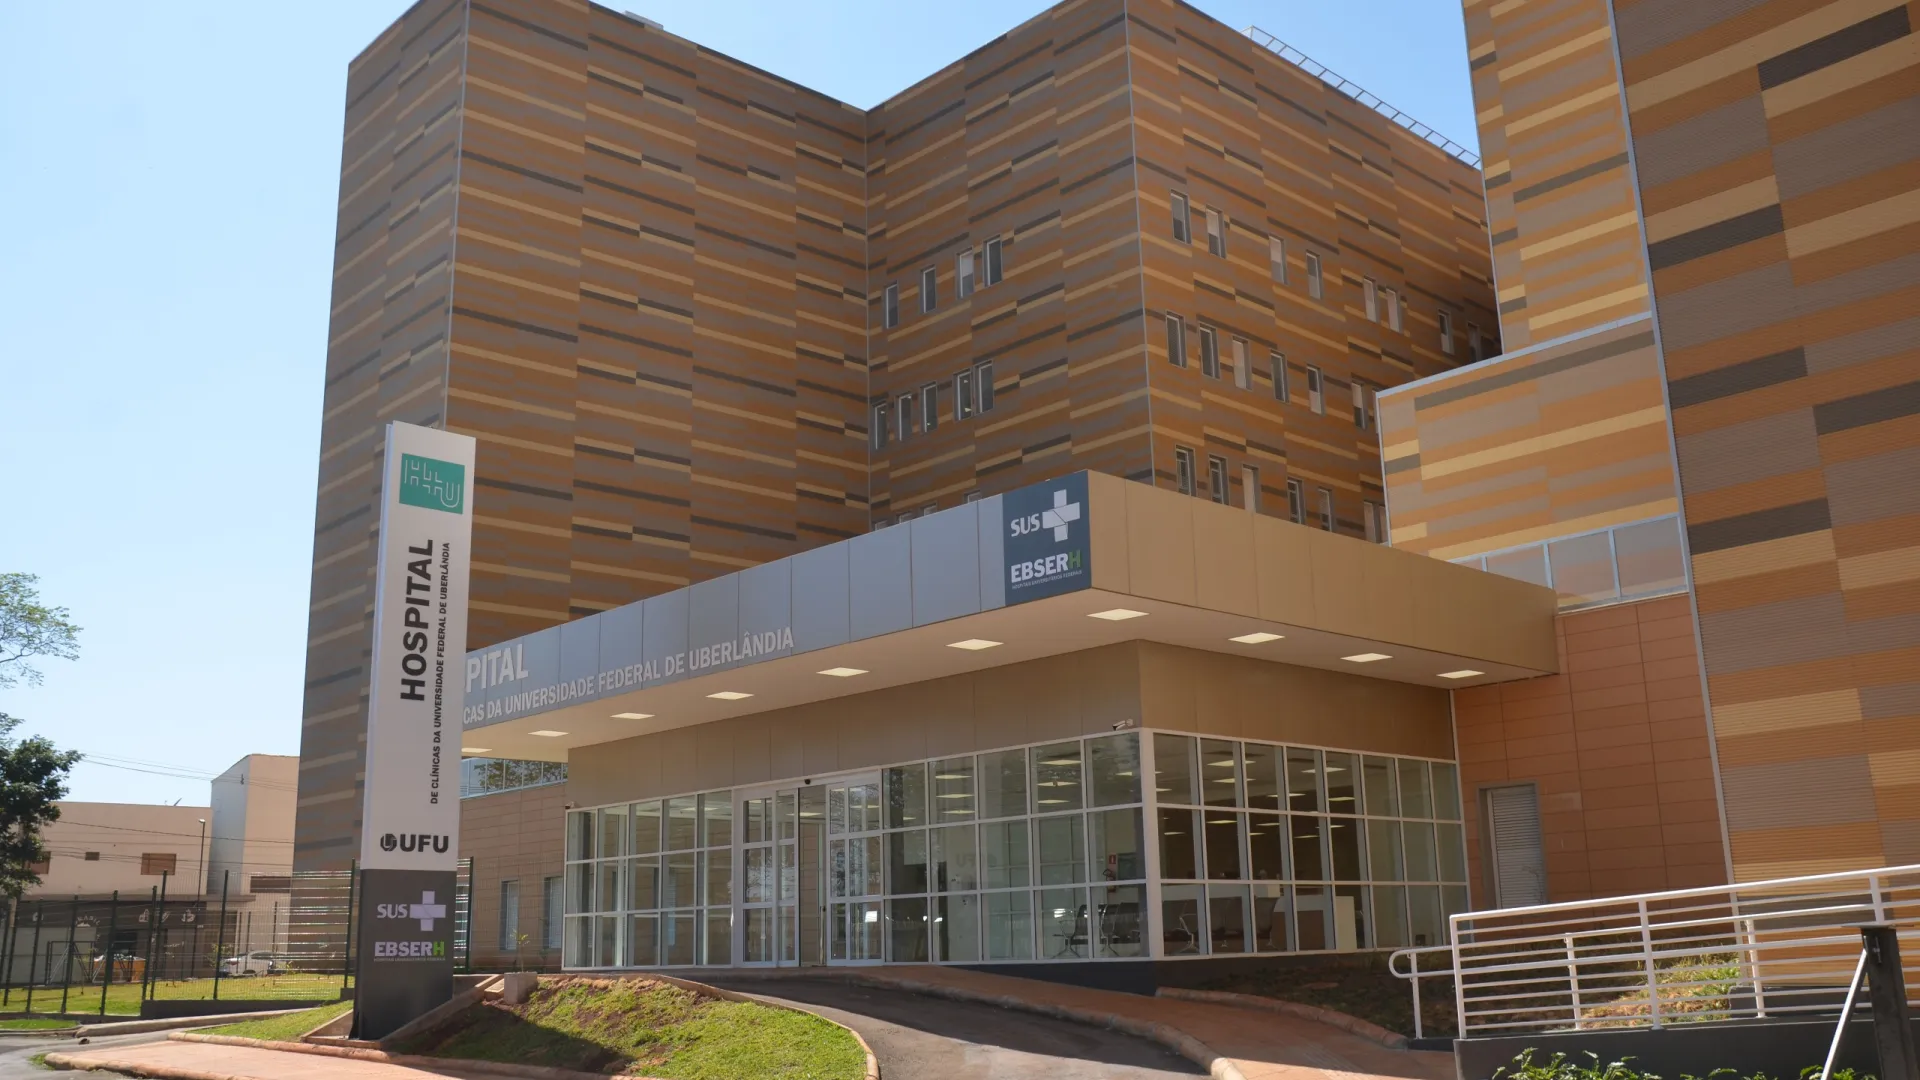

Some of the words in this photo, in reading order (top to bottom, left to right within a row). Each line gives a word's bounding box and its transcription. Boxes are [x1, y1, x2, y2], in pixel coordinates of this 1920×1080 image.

[1010, 513, 1041, 537] SUS
[440, 543, 450, 599] UBERLÂNDIA
[1011, 550, 1081, 583] EBSERH
[400, 539, 433, 701] HOSPITAL
[439, 602, 447, 614] DE
[437, 617, 446, 658] FEDERAL
[487, 700, 503, 719] DA
[505, 675, 595, 716] UNIVERSIDADE
[598, 659, 661, 693] FEDERAL
[665, 653, 685, 677] DE
[689, 626, 794, 671] UBERLÂNDIA
[434, 660, 444, 728] UNIVERSIDADE
[433, 730, 442, 743] DA
[430, 745, 441, 789] CLÍNICAS
[430, 791, 439, 804] DE
[400, 833, 449, 853] UFU
[377, 903, 408, 919] SUS
[374, 941, 445, 957] EBSERH
